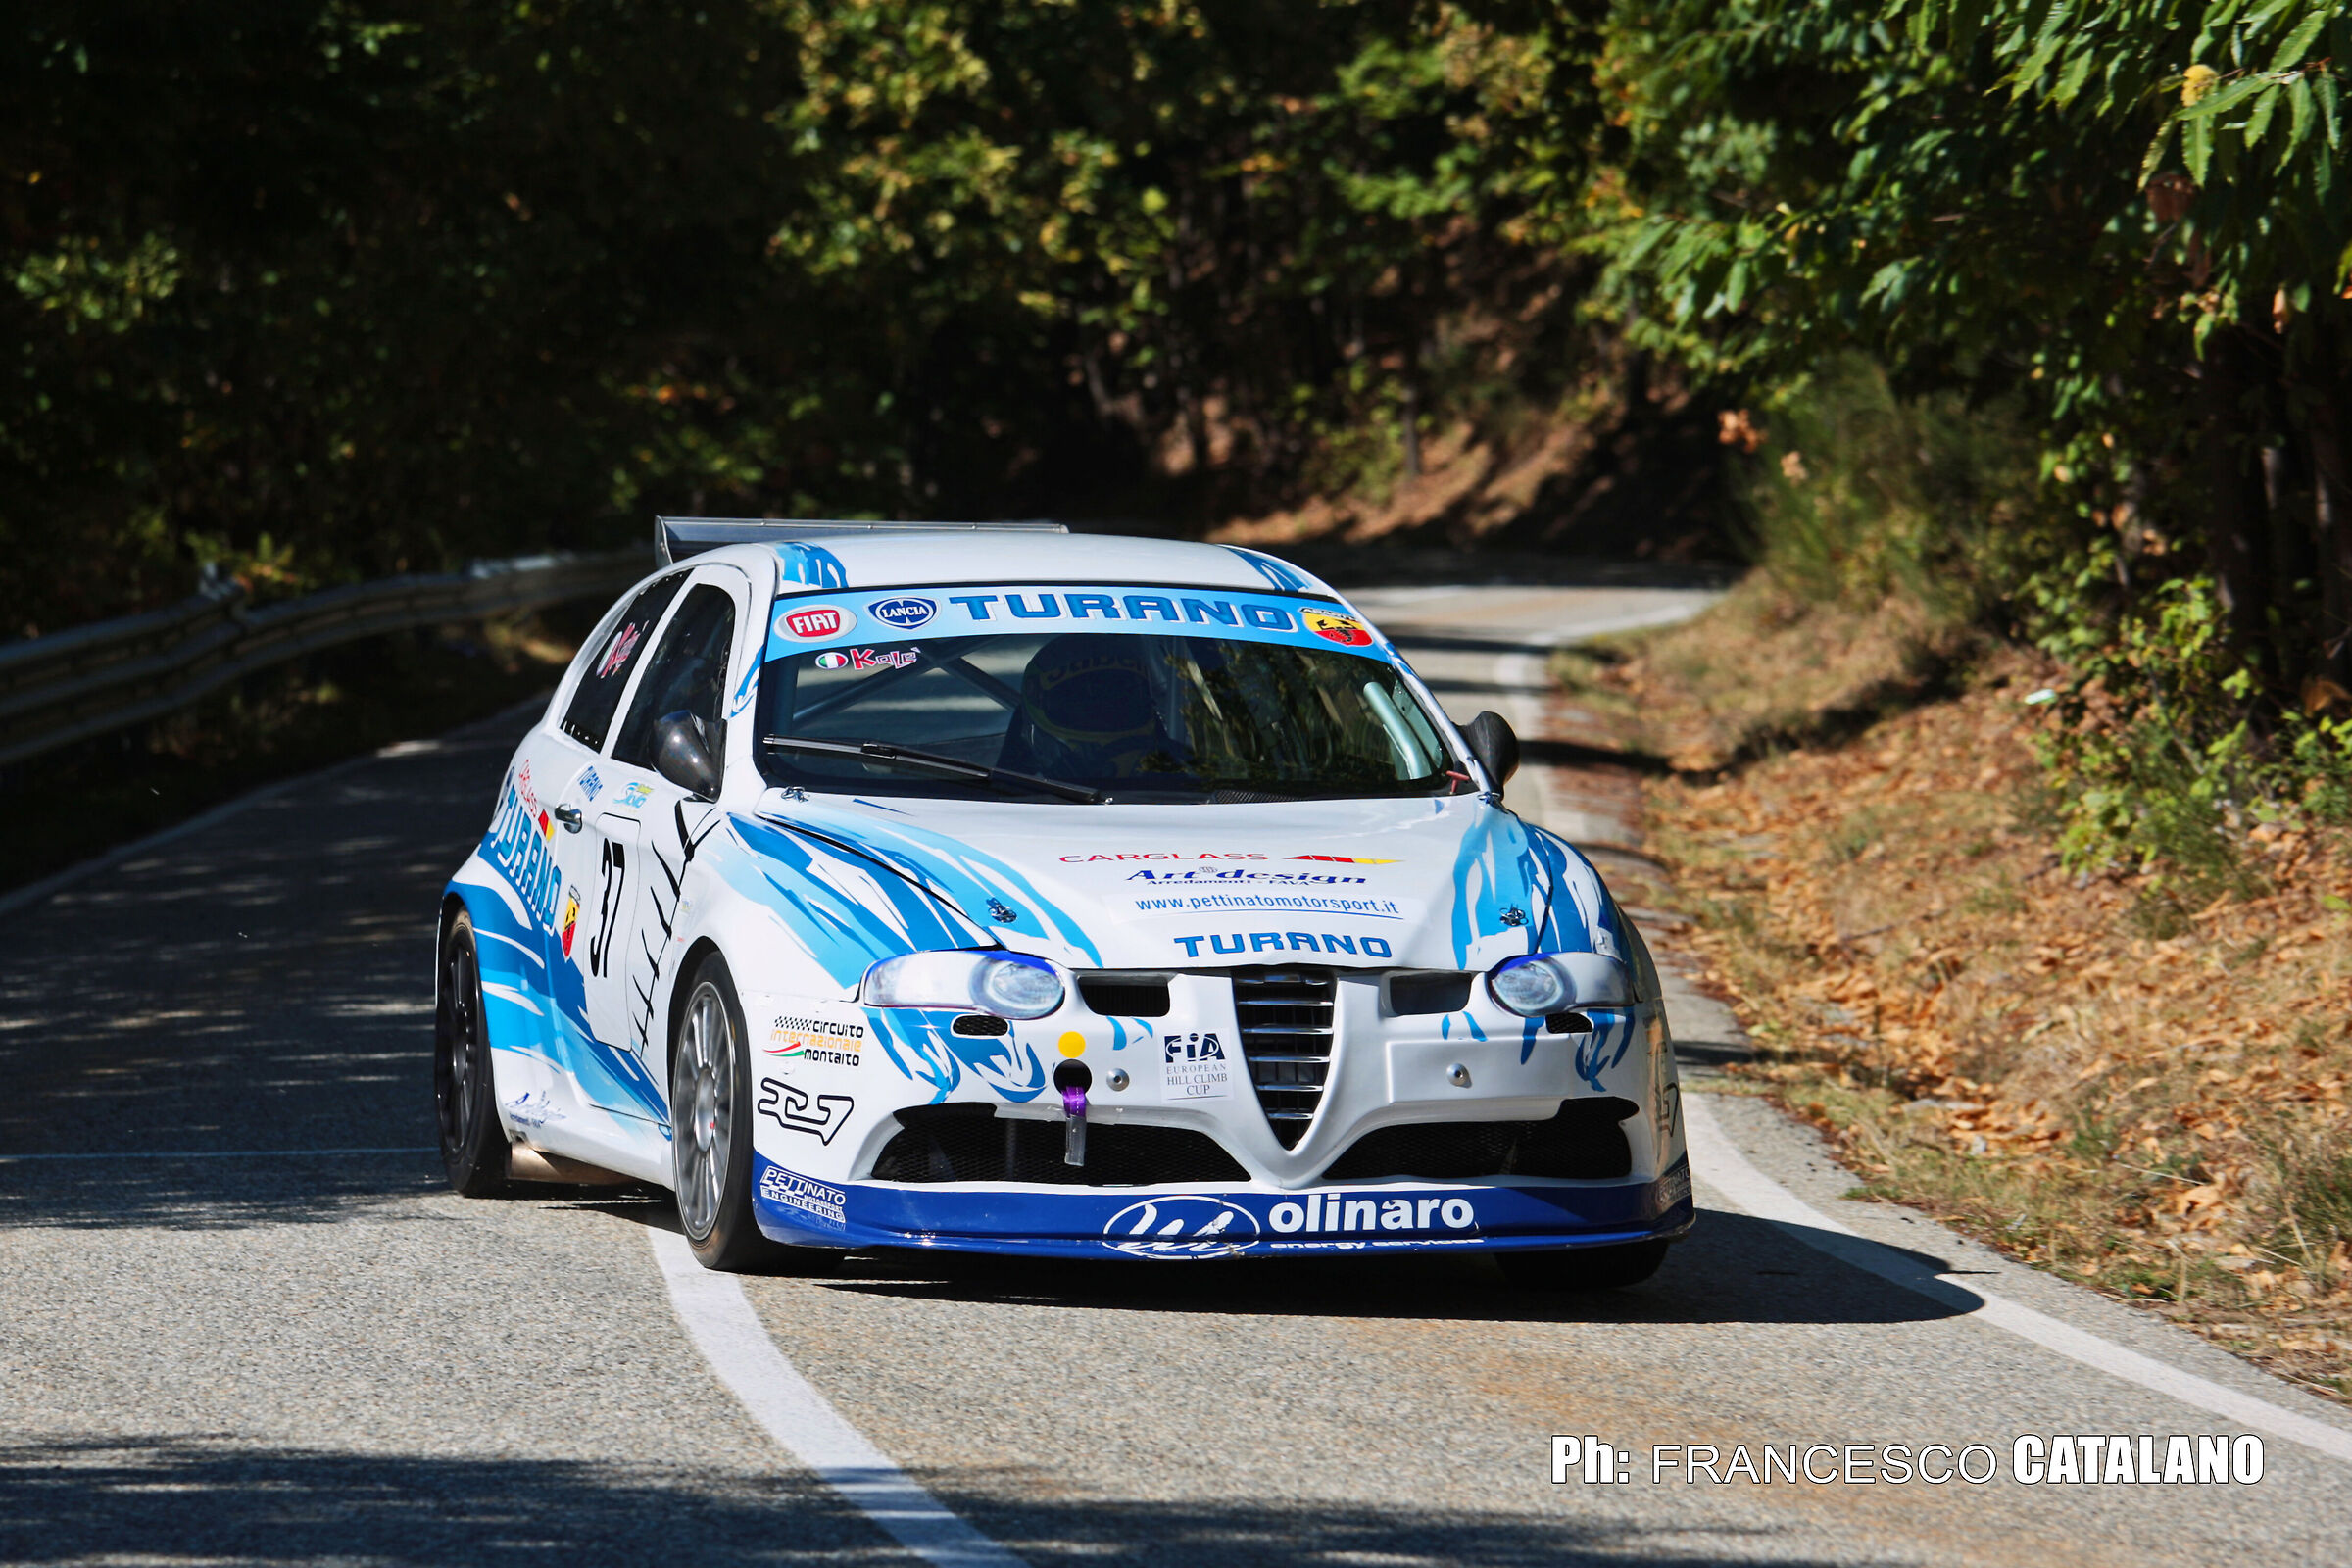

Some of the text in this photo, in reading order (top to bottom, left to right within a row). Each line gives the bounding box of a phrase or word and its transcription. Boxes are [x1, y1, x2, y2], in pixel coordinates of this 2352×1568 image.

[792, 612, 837, 634] FIAT
[882, 606, 928, 618] LANCIA
[950, 593, 1298, 633] TURANO
[490, 784, 562, 937] TURANO
[1058, 853, 1269, 863] CARGLASS
[1126, 869, 1367, 886] Art design
[590, 837, 625, 979] 37
[1135, 893, 1399, 916] www.pettinatomotorsport.it
[1174, 931, 1393, 959] TURANO
[1166, 1063, 1227, 1075] EUROPEAN
[1167, 1072, 1228, 1086] HILL CLIMB
[1186, 1084, 1210, 1096] CUP
[762, 1168, 847, 1205] PETTINATO
[763, 1188, 845, 1221] ENGINEERING
[1270, 1241, 1366, 1250] energy
